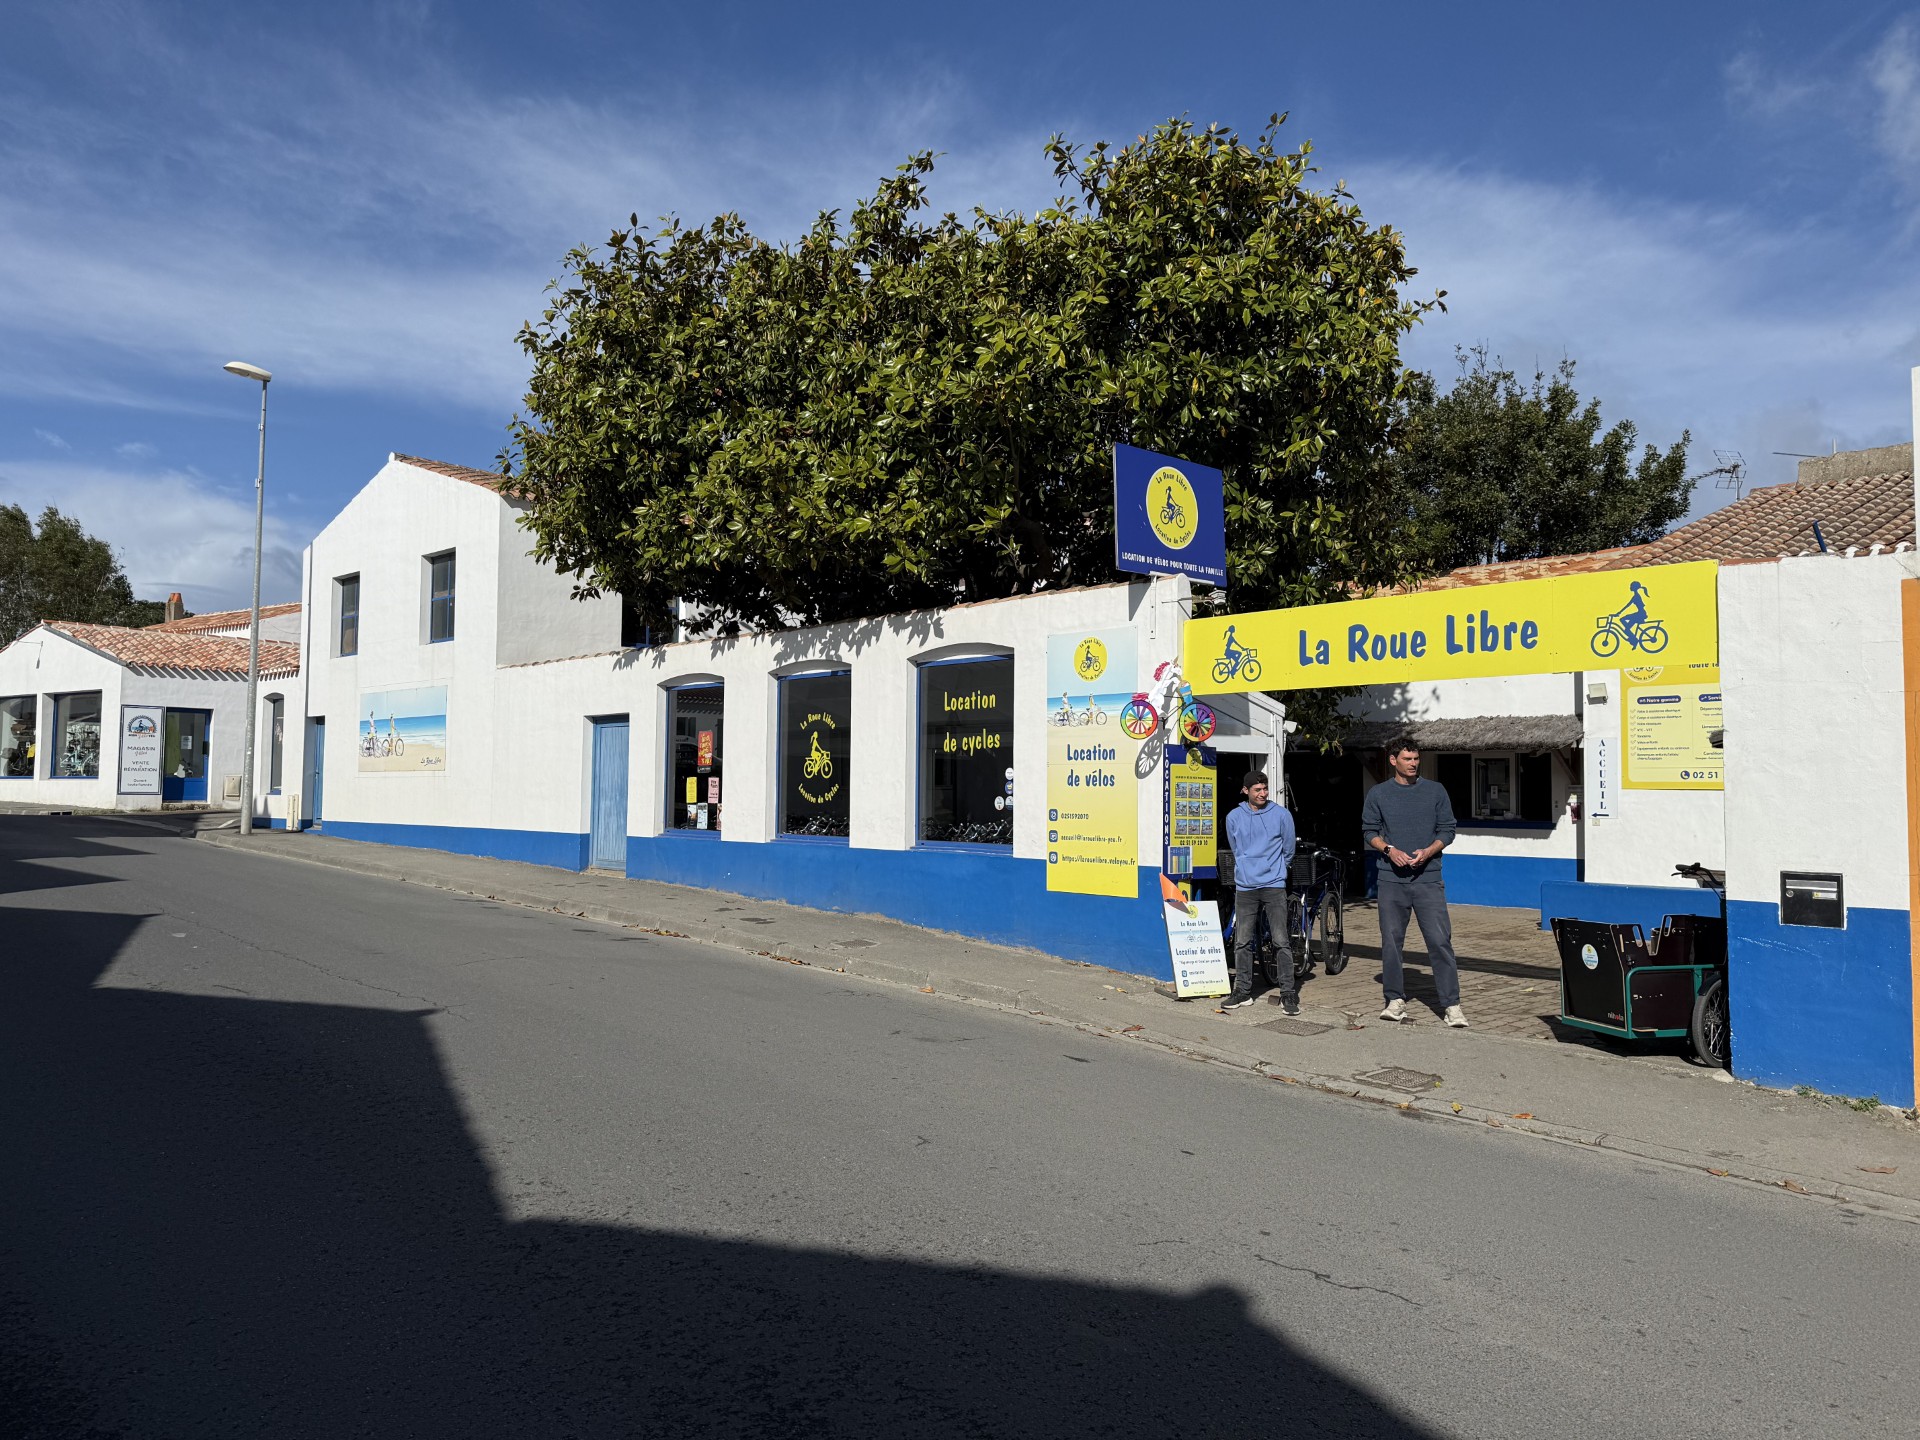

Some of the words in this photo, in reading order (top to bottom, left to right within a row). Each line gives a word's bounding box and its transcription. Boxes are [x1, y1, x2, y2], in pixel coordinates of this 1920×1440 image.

[1163, 472, 1174, 480] Roue
[1176, 475, 1187, 491] Libre
[1155, 523, 1171, 543] Location
[1121, 551, 1145, 563] LOCATION
[1147, 556, 1152, 564] DE
[1154, 557, 1168, 567] VÉLOS
[1170, 560, 1182, 569] POUR
[1184, 562, 1197, 572] TOUTE
[1206, 567, 1223, 576] FAMILLE
[1299, 630, 1329, 666] La
[1348, 623, 1426, 662] Roue
[1446, 610, 1538, 655] Libre
[944, 690, 996, 711] Location
[800, 721, 807, 730] La
[808, 713, 821, 722] Roue
[823, 712, 836, 729] Libre
[943, 732, 957, 752] de
[962, 728, 1001, 756] cycles
[1067, 743, 1115, 761] Location
[1067, 769, 1080, 786] de
[1085, 769, 1115, 787] vélos
[1599, 739, 1607, 809] ACCUEIL
[1692, 771, 1704, 779] 02
[799, 783, 816, 803] Location
[818, 795, 824, 803] de
[825, 783, 839, 801] Cycles
